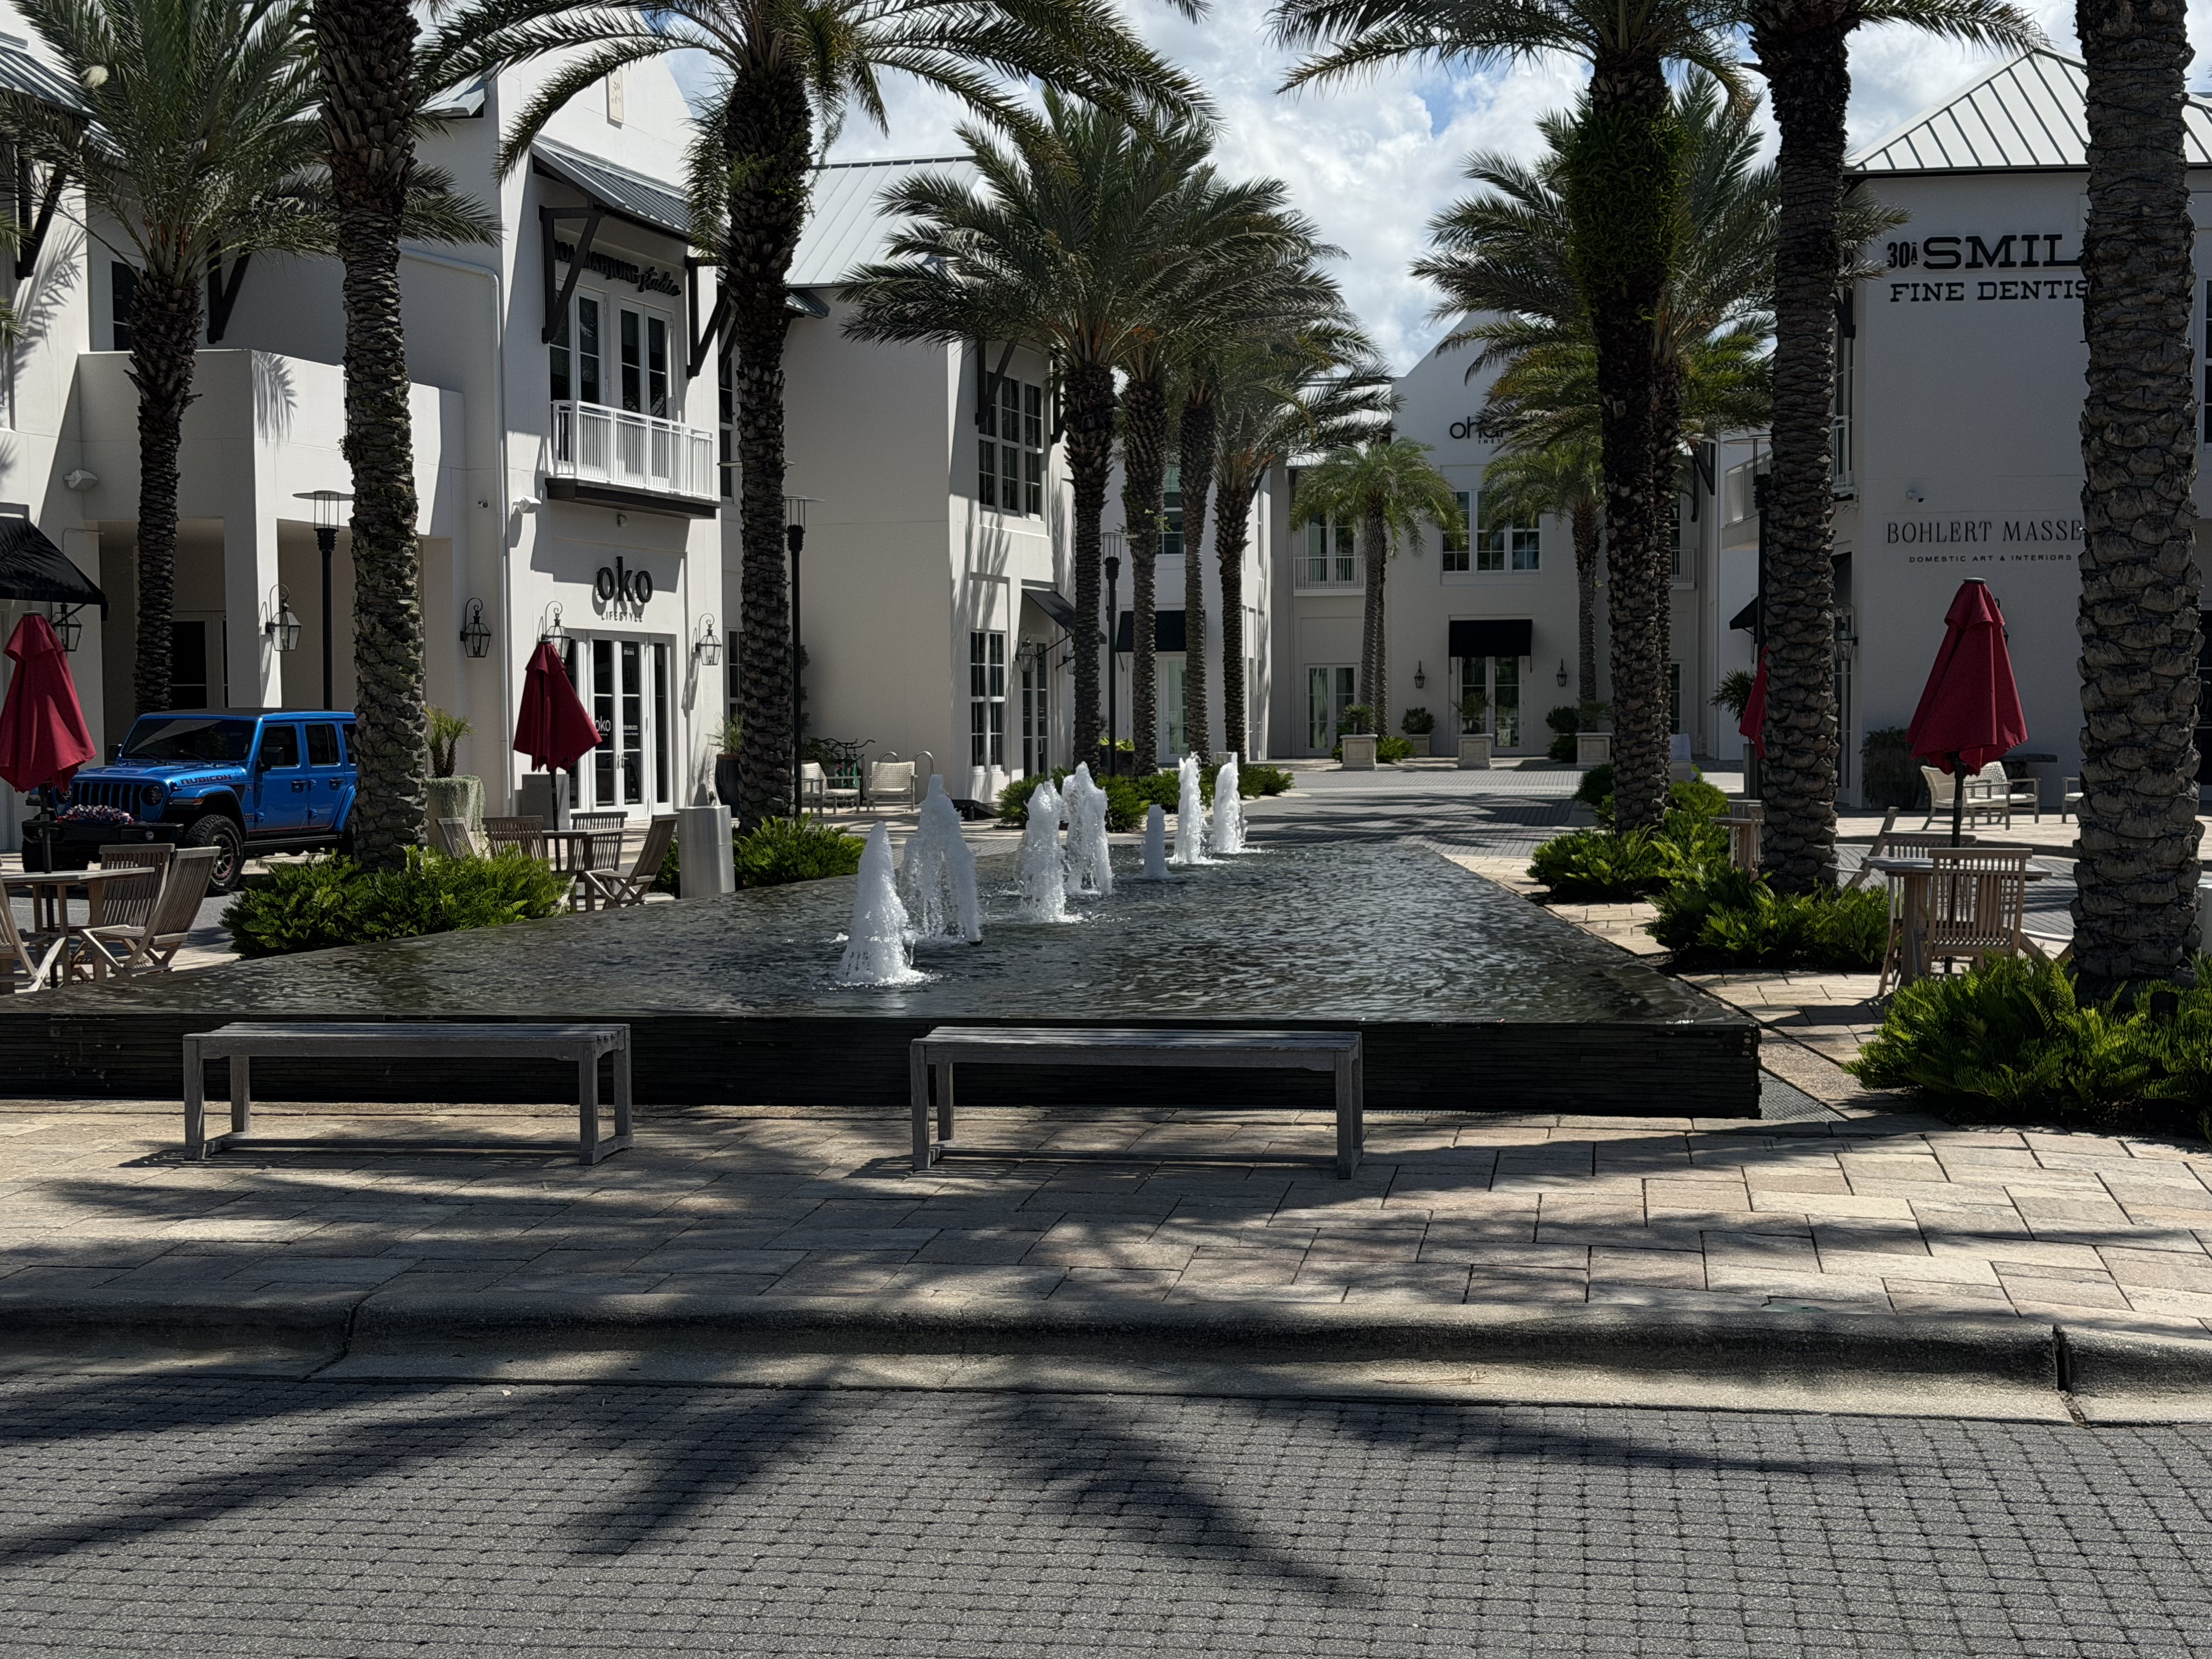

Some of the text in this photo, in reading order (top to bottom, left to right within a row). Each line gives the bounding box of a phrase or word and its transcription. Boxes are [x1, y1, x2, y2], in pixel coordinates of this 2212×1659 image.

[1923, 235, 2081, 269] SMIL
[1890, 280, 2088, 302] FINE DENTIS
[1887, 520, 2082, 544] BOHLERT MASSE
[596, 556, 653, 603] oko
[601, 611, 643, 623] LIFESTYLE
[595, 715, 611, 732] oko
[180, 774, 232, 785] RUBICON
